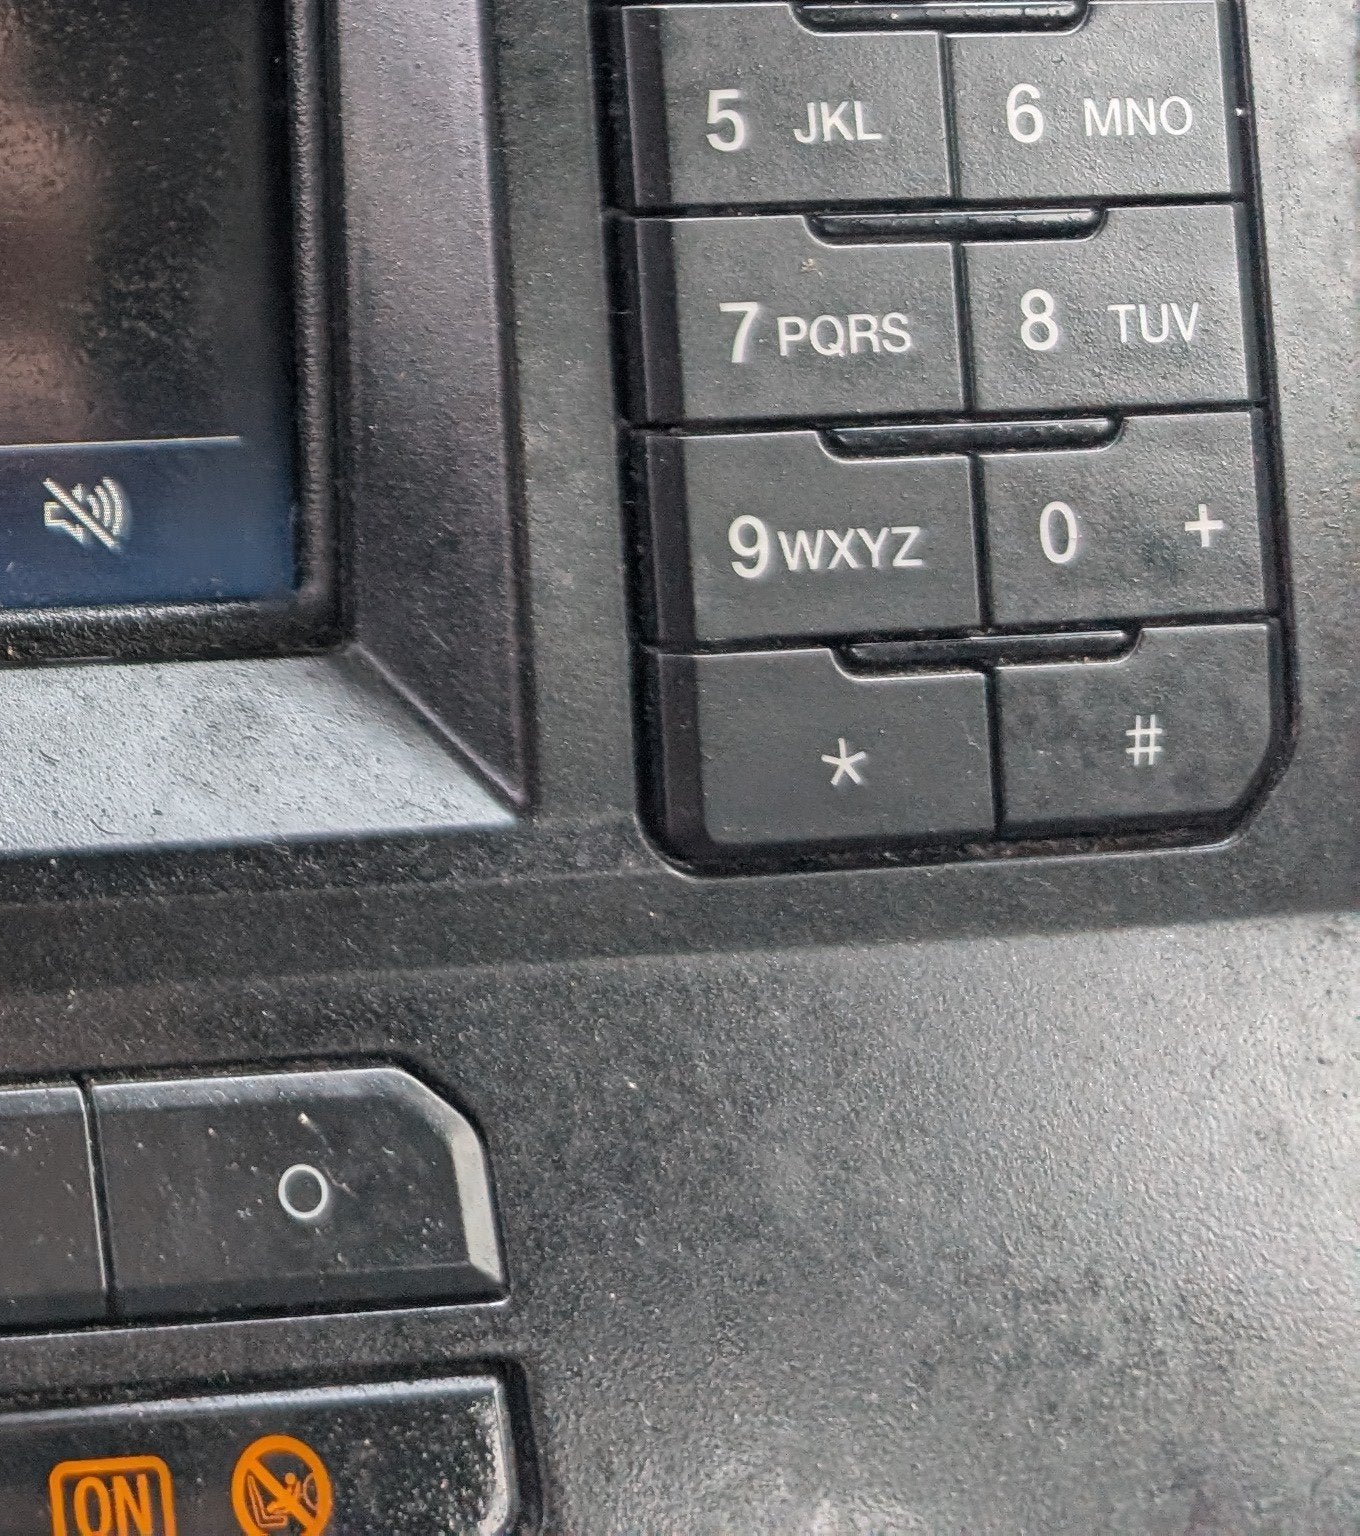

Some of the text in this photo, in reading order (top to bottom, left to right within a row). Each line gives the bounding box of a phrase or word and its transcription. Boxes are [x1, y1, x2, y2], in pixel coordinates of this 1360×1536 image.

[706, 89, 882, 152] 5 JKL
[1006, 83, 1193, 143] 6 MNO
[720, 302, 913, 363] 7 PQRS
[1020, 289, 1200, 351] 8 TUV
[728, 514, 924, 579] 9 WXYZ
[1039, 501, 1078, 564] 0
[73, 1472, 154, 1536] ON
